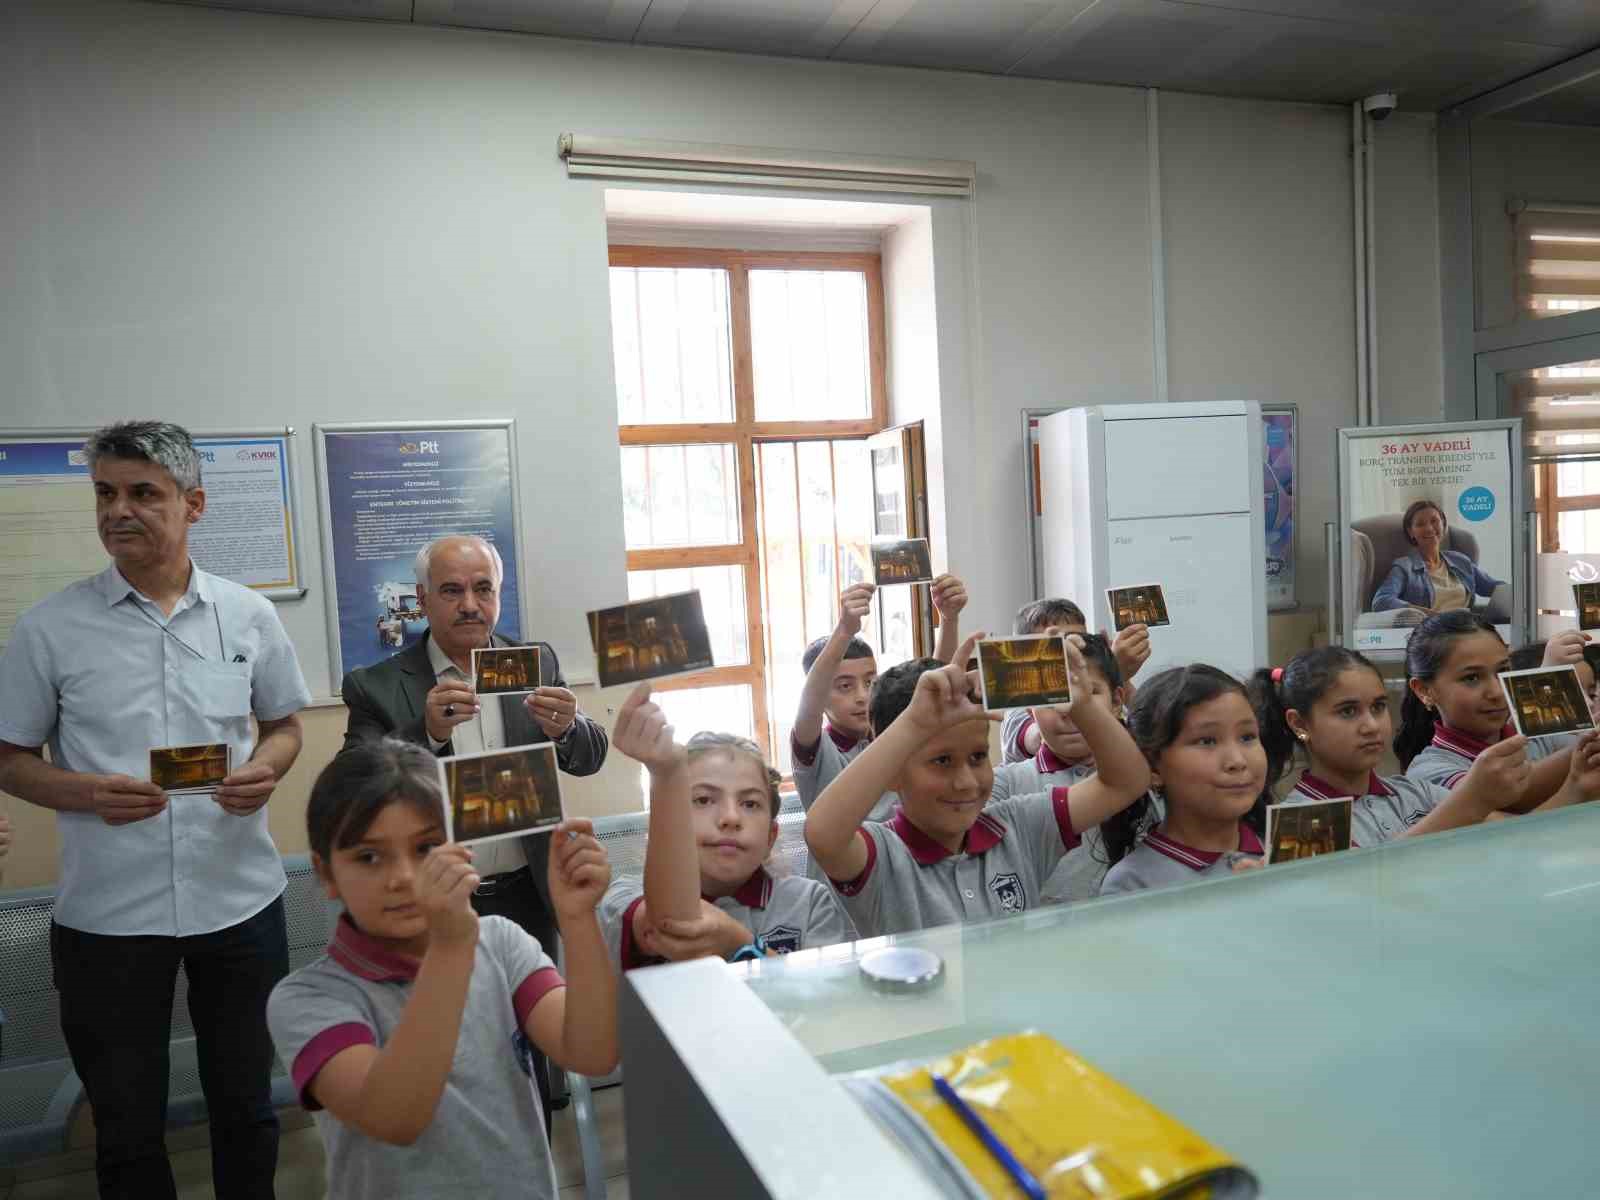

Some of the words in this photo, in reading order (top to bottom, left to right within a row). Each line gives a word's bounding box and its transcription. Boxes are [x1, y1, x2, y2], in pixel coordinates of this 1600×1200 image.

[419, 441, 440, 454] Ptt
[1381, 444, 1398, 455] 36
[1401, 442, 1420, 454] AY
[1423, 438, 1472, 453] VADELİ
